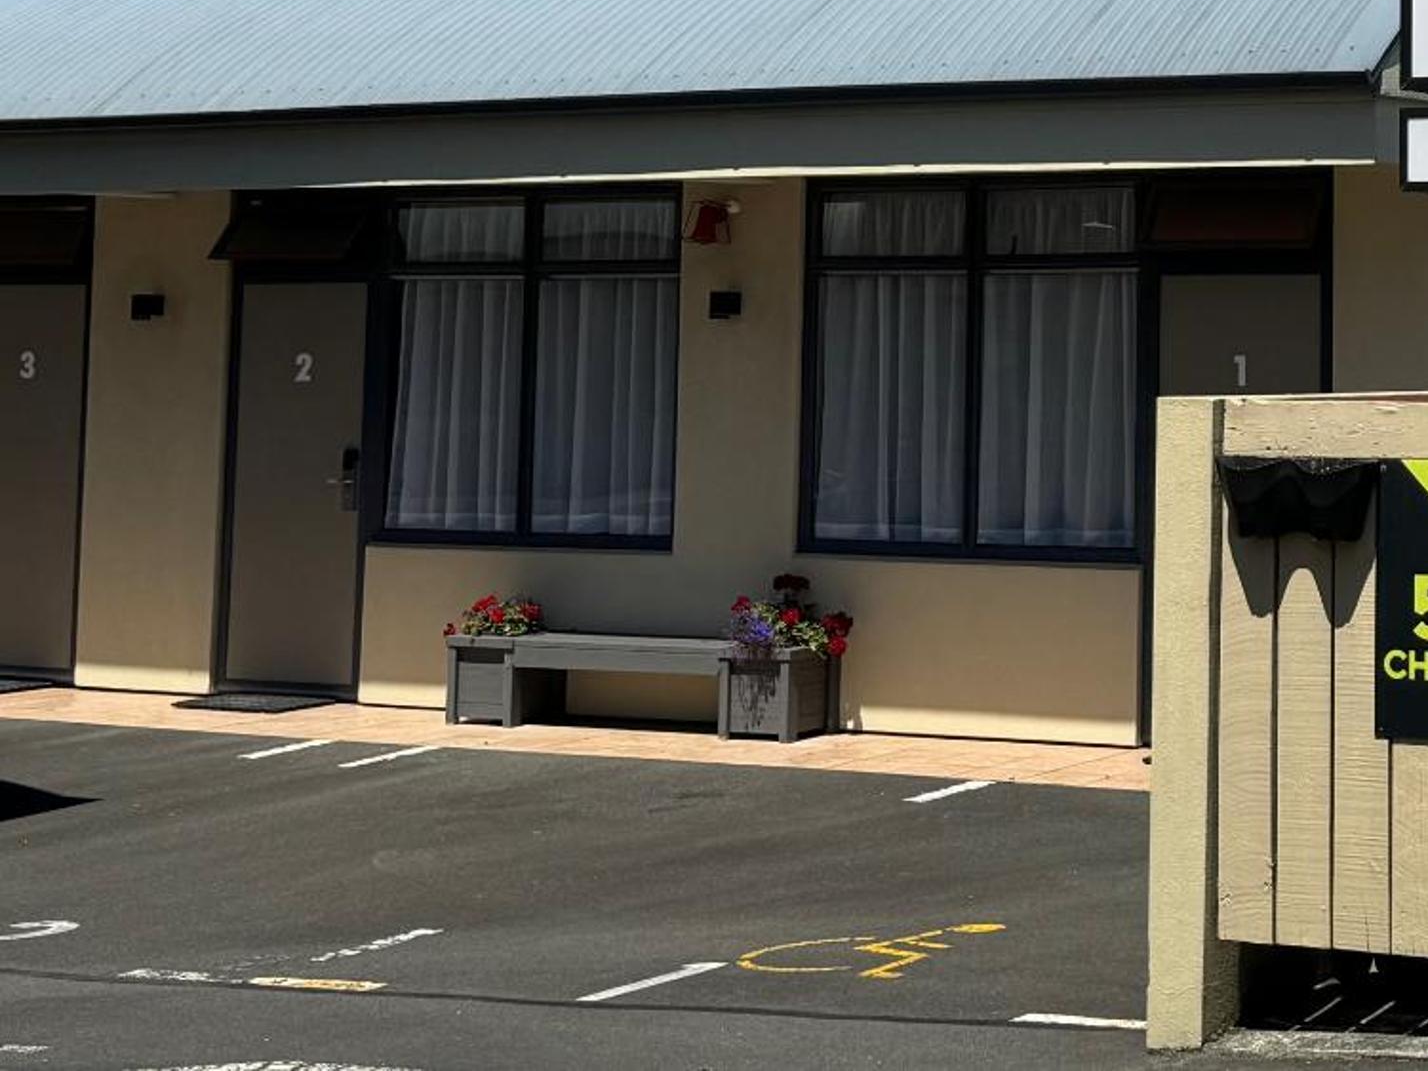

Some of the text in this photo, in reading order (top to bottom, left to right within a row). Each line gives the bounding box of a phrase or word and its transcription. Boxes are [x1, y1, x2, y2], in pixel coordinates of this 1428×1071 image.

[19, 350, 36, 380] 3
[294, 352, 313, 383] 2
[1233, 353, 1248, 387] 1
